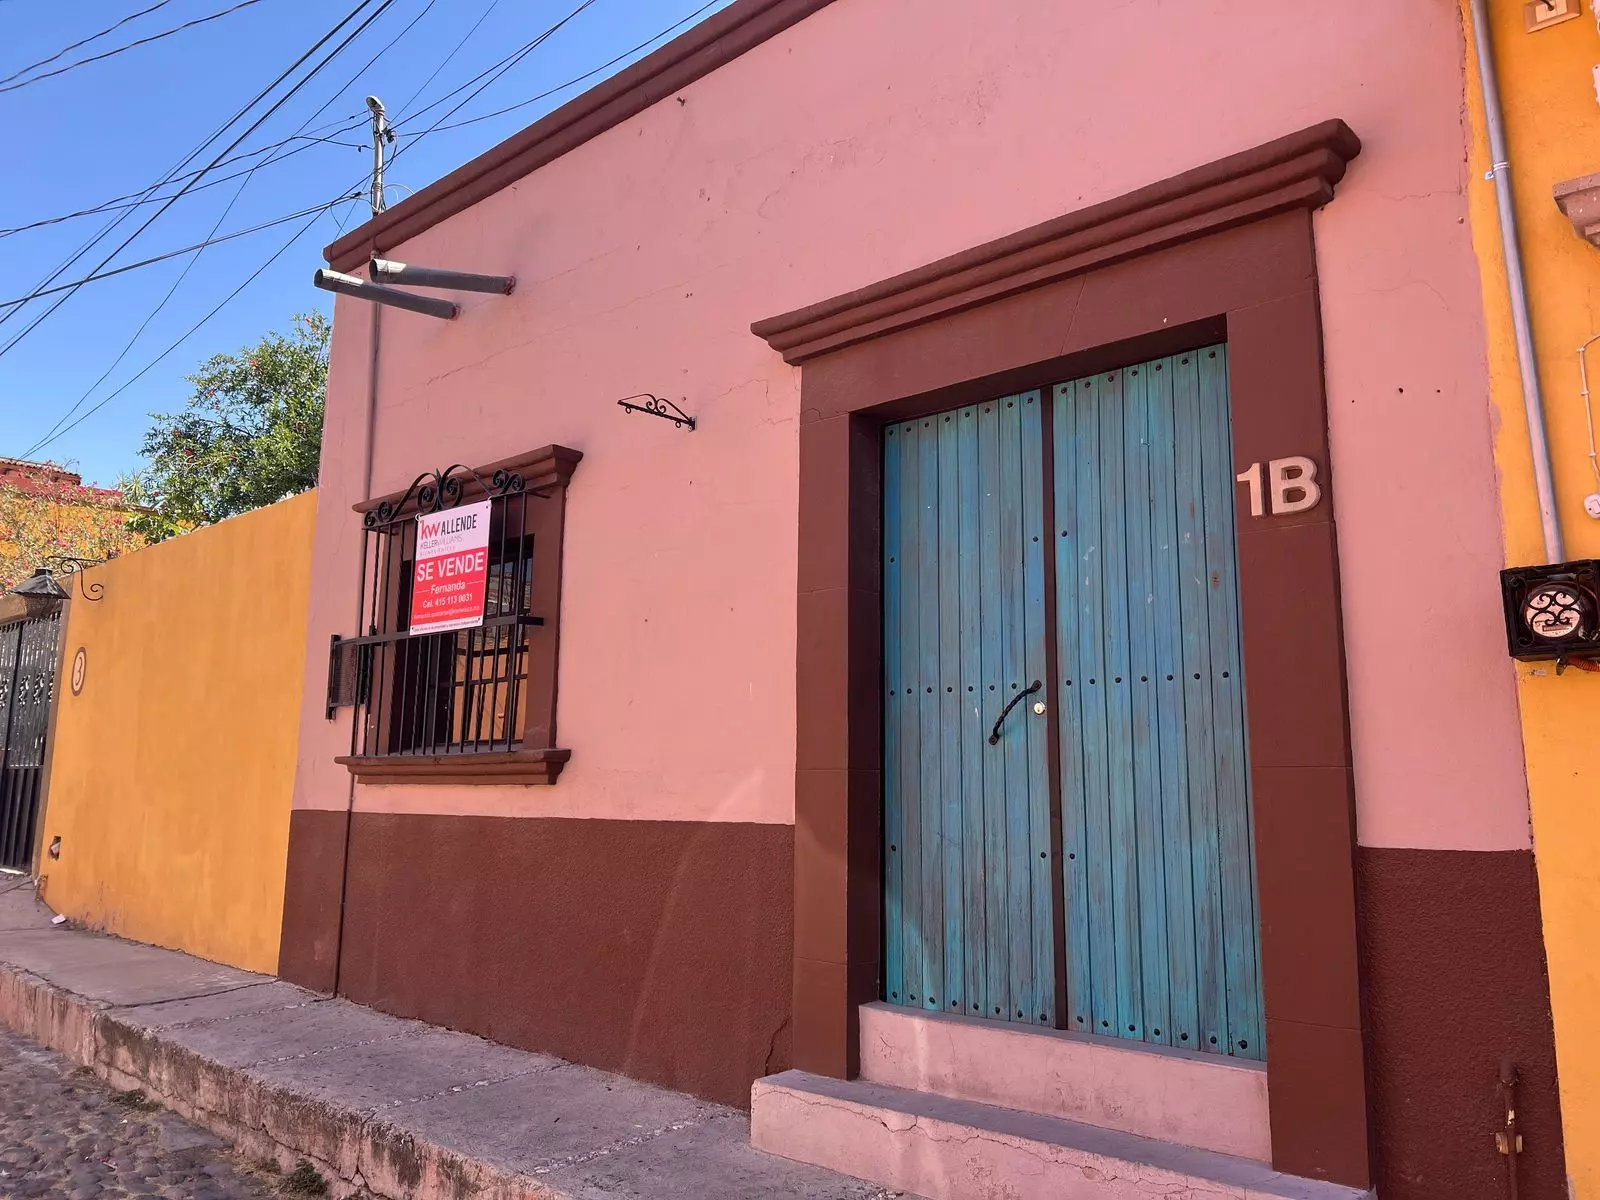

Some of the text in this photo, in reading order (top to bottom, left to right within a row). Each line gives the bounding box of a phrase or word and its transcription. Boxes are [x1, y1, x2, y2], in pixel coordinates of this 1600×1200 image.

[1237, 456, 1321, 516] 1B
[441, 514, 478, 536] ALLENDE
[417, 552, 485, 582] SE VENDE
[430, 580, 466, 595] Fernanda
[435, 597, 446, 607] 415
